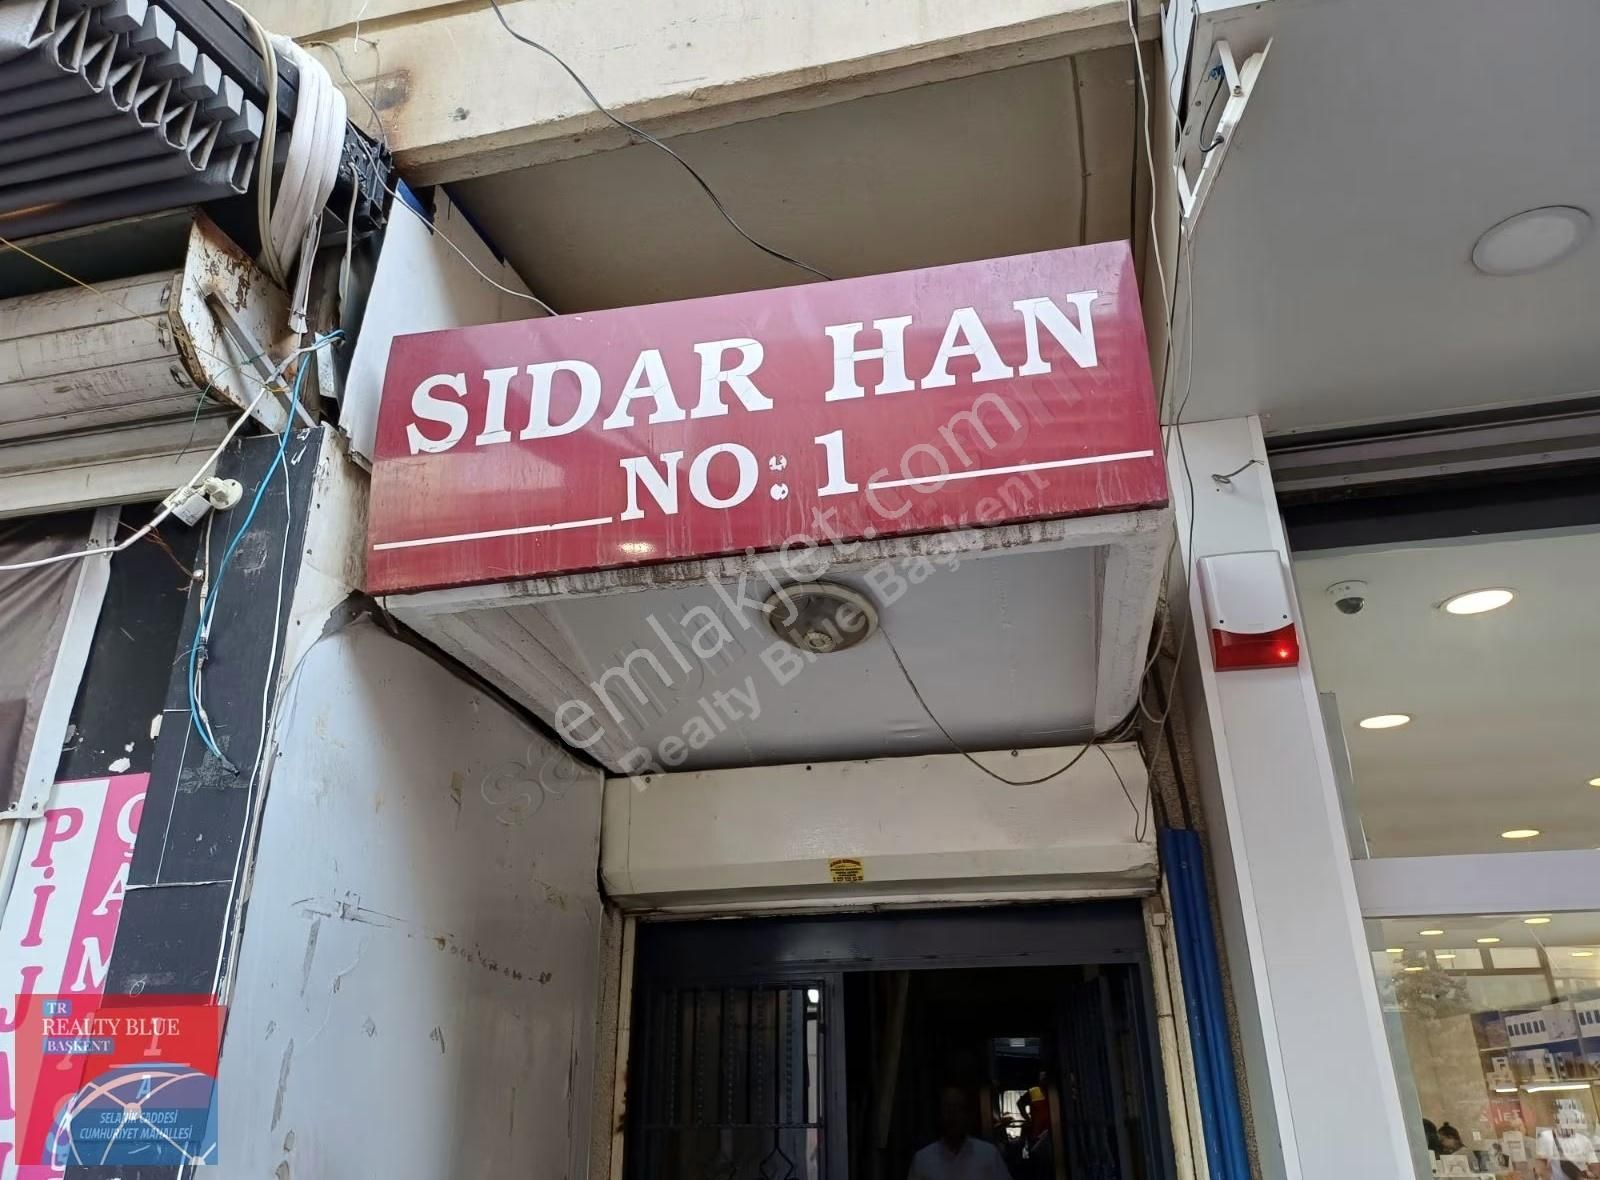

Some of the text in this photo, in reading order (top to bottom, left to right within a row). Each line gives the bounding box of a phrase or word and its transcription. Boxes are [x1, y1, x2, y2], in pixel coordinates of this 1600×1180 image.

[406, 290, 1099, 455] SIDAR HAN
[620, 429, 858, 521] NO: 1
